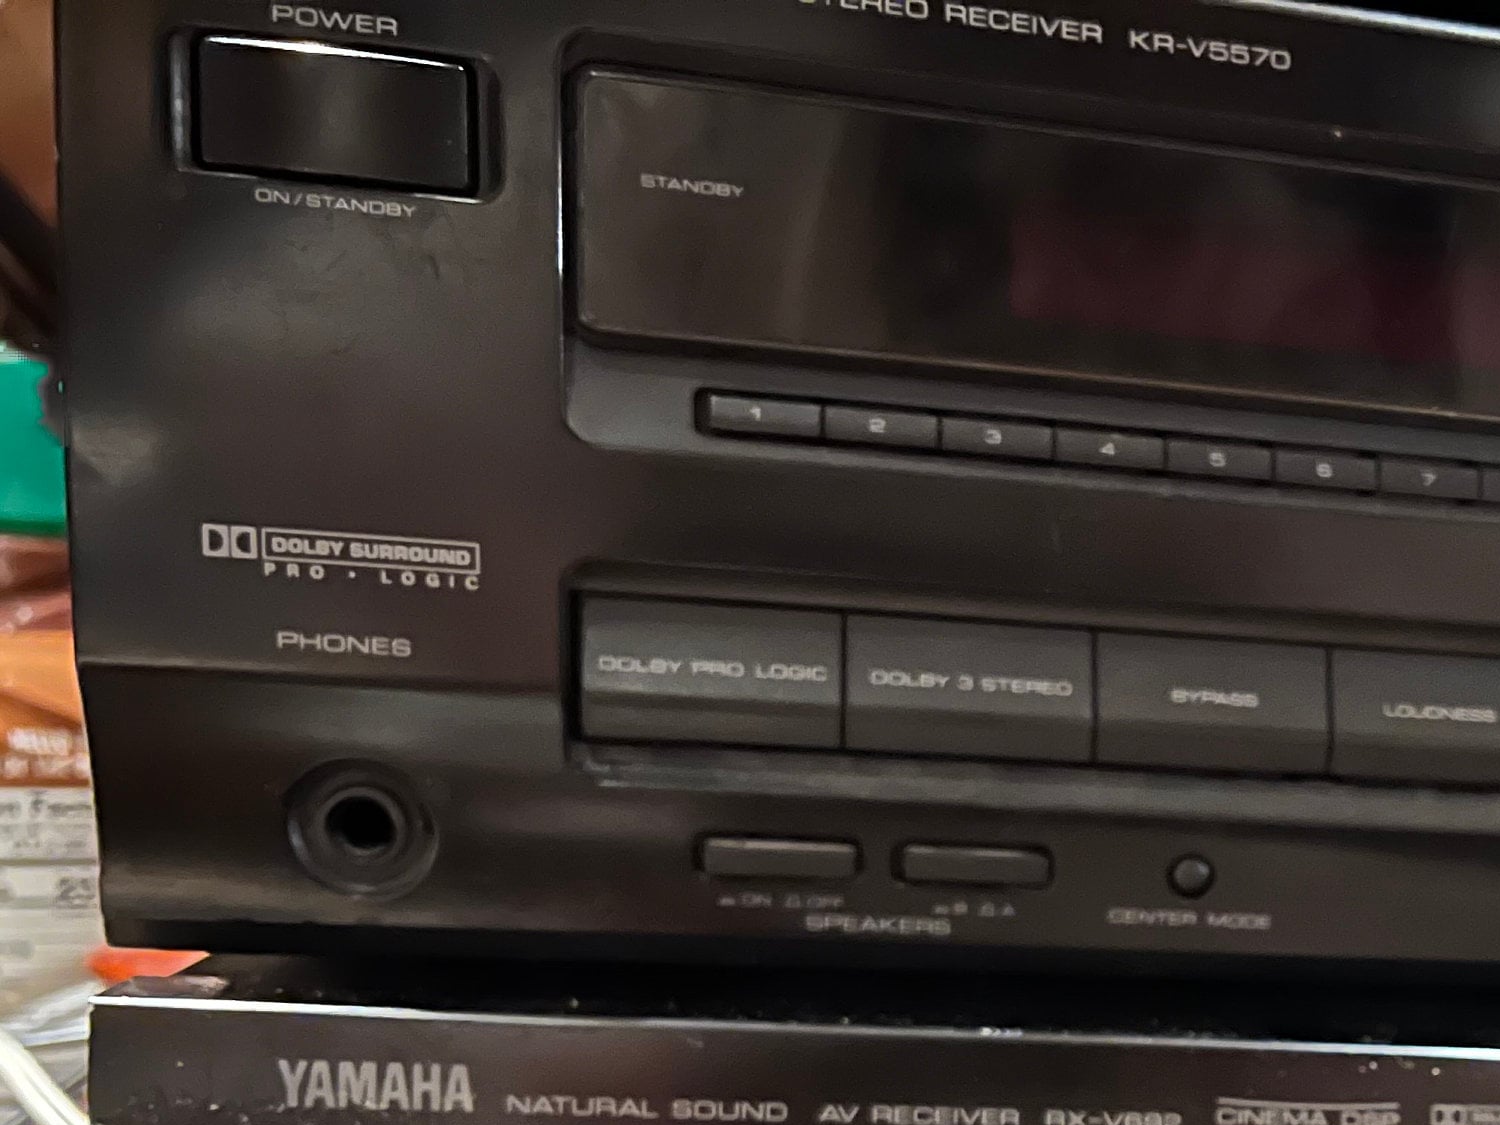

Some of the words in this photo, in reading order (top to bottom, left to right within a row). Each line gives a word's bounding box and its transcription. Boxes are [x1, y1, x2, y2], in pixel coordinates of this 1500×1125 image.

[270, 4, 398, 38] POWER
[800, 0, 930, 20] EREO
[945, 3, 1103, 44] RECEIVER
[1129, 29, 1292, 71] KR-V5570
[640, 173, 745, 198] STANDBY
[254, 187, 420, 218] ON/STANDBY
[749, 406, 762, 421] 1
[868, 416, 887, 434] 2
[984, 428, 1003, 445] 3
[1099, 439, 1117, 456] 4
[270, 536, 345, 558] DOLBY
[349, 542, 472, 567] SURROUND
[276, 630, 413, 658] PHONES
[598, 655, 682, 678] DOLBY
[690, 659, 745, 678] PRO
[754, 663, 828, 682] LOGIC
[868, 669, 949, 688] DOLBY
[957, 674, 974, 691] 3
[980, 676, 1073, 697] STEREO
[805, 911, 952, 935] SPEAKERS
[276, 1058, 475, 1114] YAMAHA
[506, 1094, 658, 1119] NATURAL
[672, 1099, 788, 1122] SOUND
[818, 1104, 859, 1124] AV
